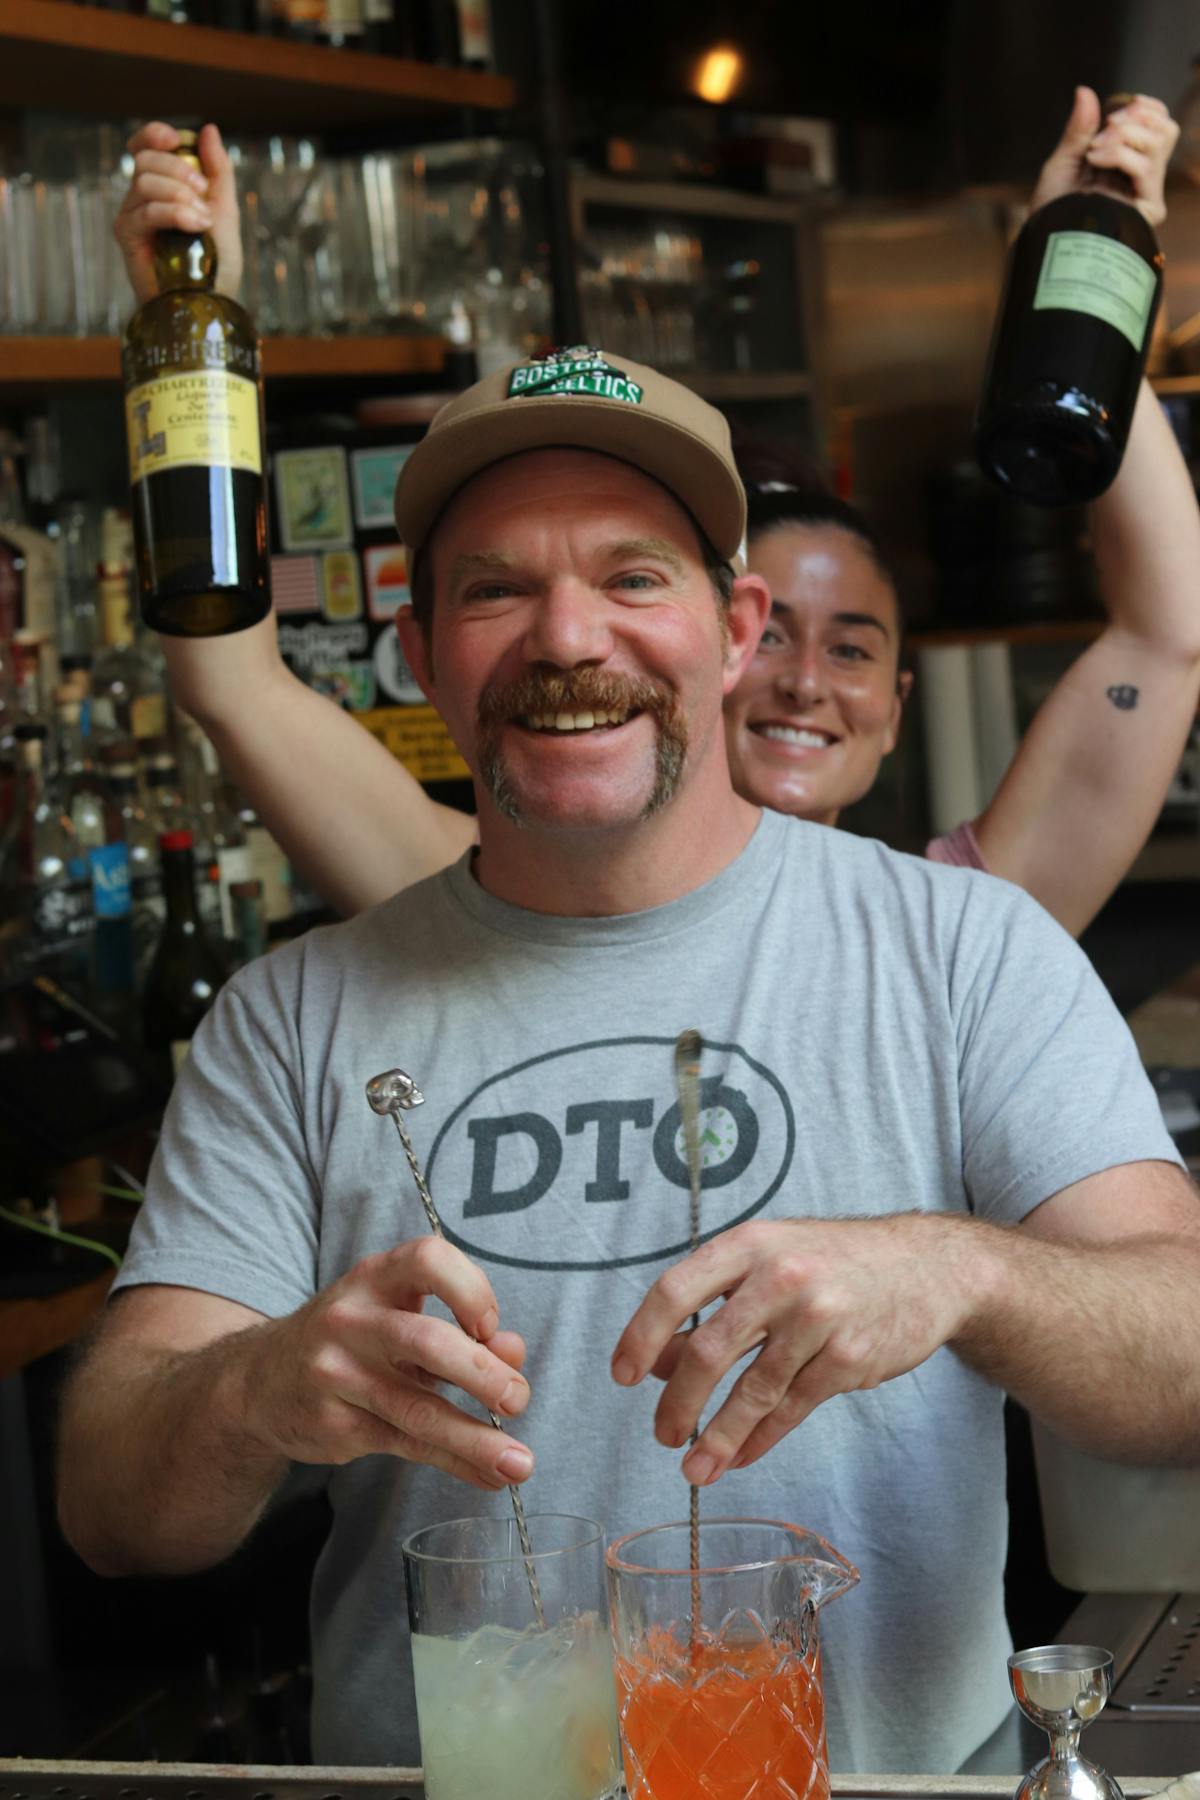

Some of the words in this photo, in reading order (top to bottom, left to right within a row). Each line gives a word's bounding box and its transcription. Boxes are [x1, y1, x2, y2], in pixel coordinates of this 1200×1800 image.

[149, 376, 244, 395] CHARTRSE
[511, 360, 609, 389] BOSTON
[463, 1076, 759, 1219] DTO
